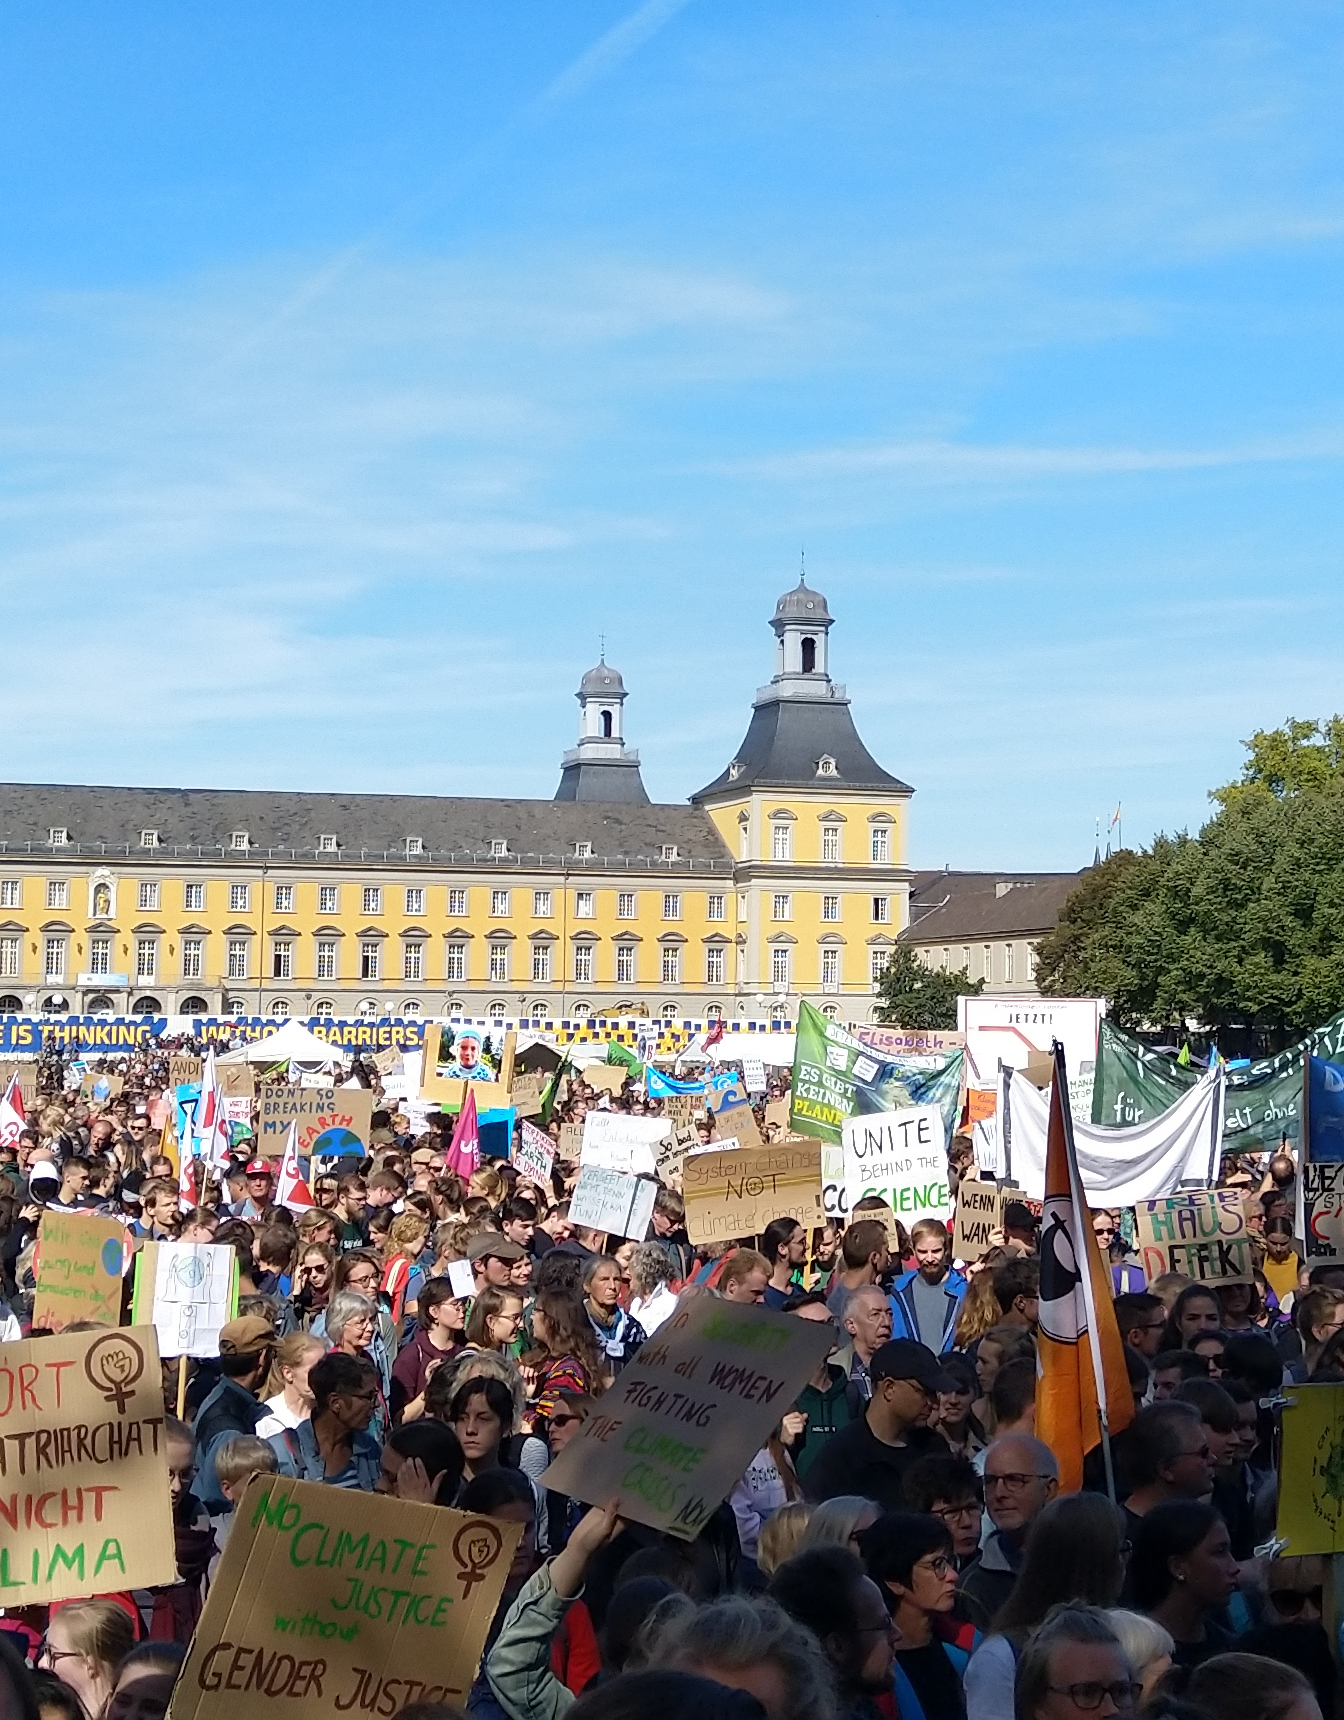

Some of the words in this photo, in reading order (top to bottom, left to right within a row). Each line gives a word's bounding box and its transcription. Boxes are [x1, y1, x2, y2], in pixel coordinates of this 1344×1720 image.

[1008, 1013, 1053, 1025] JETZT!
[11, 1025, 32, 1044] IS
[41, 1025, 151, 1045] THINKING
[201, 1026, 277, 1044] WITHO
[171, 1061, 200, 1077] ANDI
[799, 1064, 820, 1083] ES
[822, 1075, 857, 1098] GIBT
[263, 1101, 336, 1116] BREAKING
[690, 1095, 703, 1104] THE
[794, 1099, 845, 1125] PLANE
[795, 1082, 855, 1114] KEINEN
[1113, 1092, 1144, 1124] für
[263, 1119, 292, 1135] MY
[1222, 1106, 1253, 1131] elt
[1263, 1099, 1297, 1122] ohne
[298, 1113, 354, 1149] EARTH
[851, 1117, 932, 1159] UNITE
[520, 1145, 548, 1174] EARTH
[659, 1139, 673, 1156] So
[859, 1158, 913, 1182] BEHIND
[916, 1156, 940, 1169] THE
[725, 1172, 786, 1202] NOT
[961, 1190, 996, 1213] WENN
[1136, 1190, 1239, 1212] TREIB
[961, 1221, 996, 1245] WAN
[1150, 1203, 1244, 1243] HAUS
[635, 1345, 668, 1367] with
[674, 1355, 703, 1378] all
[708, 1361, 786, 1405] WOMEN
[623, 1380, 718, 1427] FIGHTING
[583, 1415, 623, 1443] THE
[251, 1491, 302, 1532] NO
[289, 1522, 438, 1577] CLIMATE
[331, 1577, 455, 1628] JUSTICE
[197, 1641, 329, 1700] GENDER
